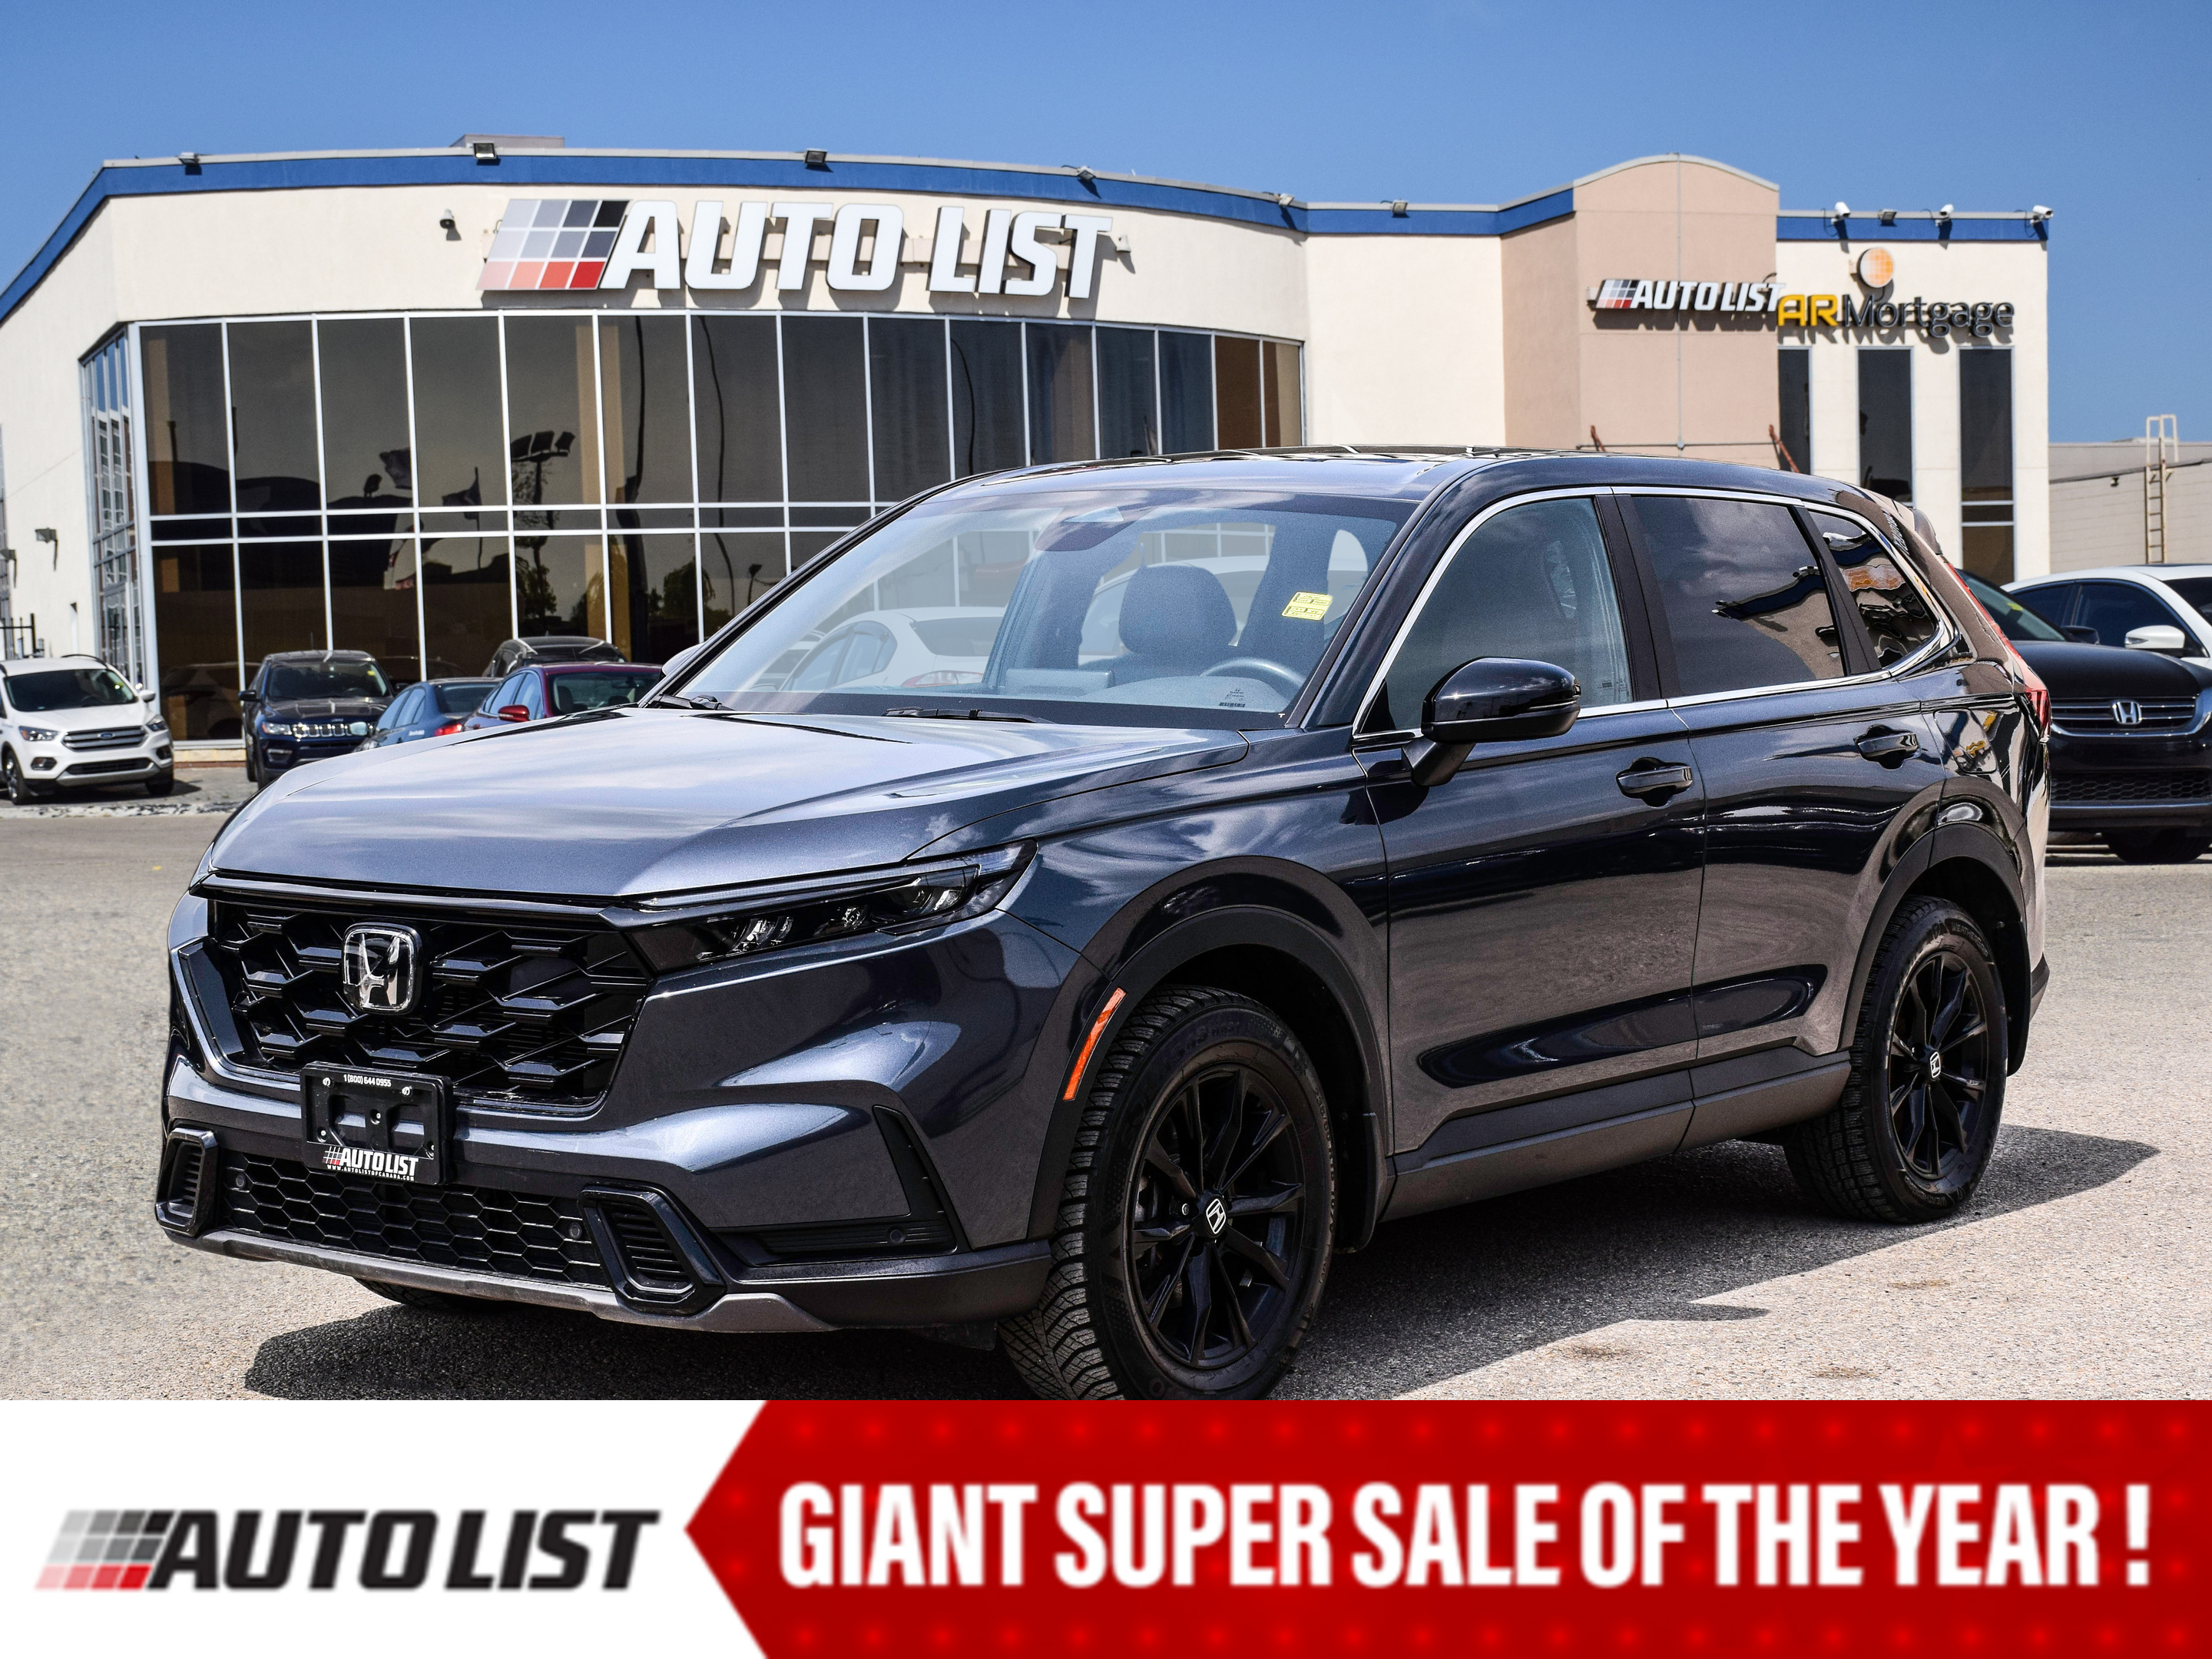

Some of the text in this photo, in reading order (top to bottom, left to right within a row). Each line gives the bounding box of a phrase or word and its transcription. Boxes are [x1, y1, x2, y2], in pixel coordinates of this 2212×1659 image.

[600, 200, 1113, 299] AUTO LIST
[1630, 280, 1786, 312] AUTO LIST
[1777, 293, 2015, 338] AR Mortgage
[363, 1076, 376, 1085] 644
[339, 1147, 419, 1177] AUTO LIST
